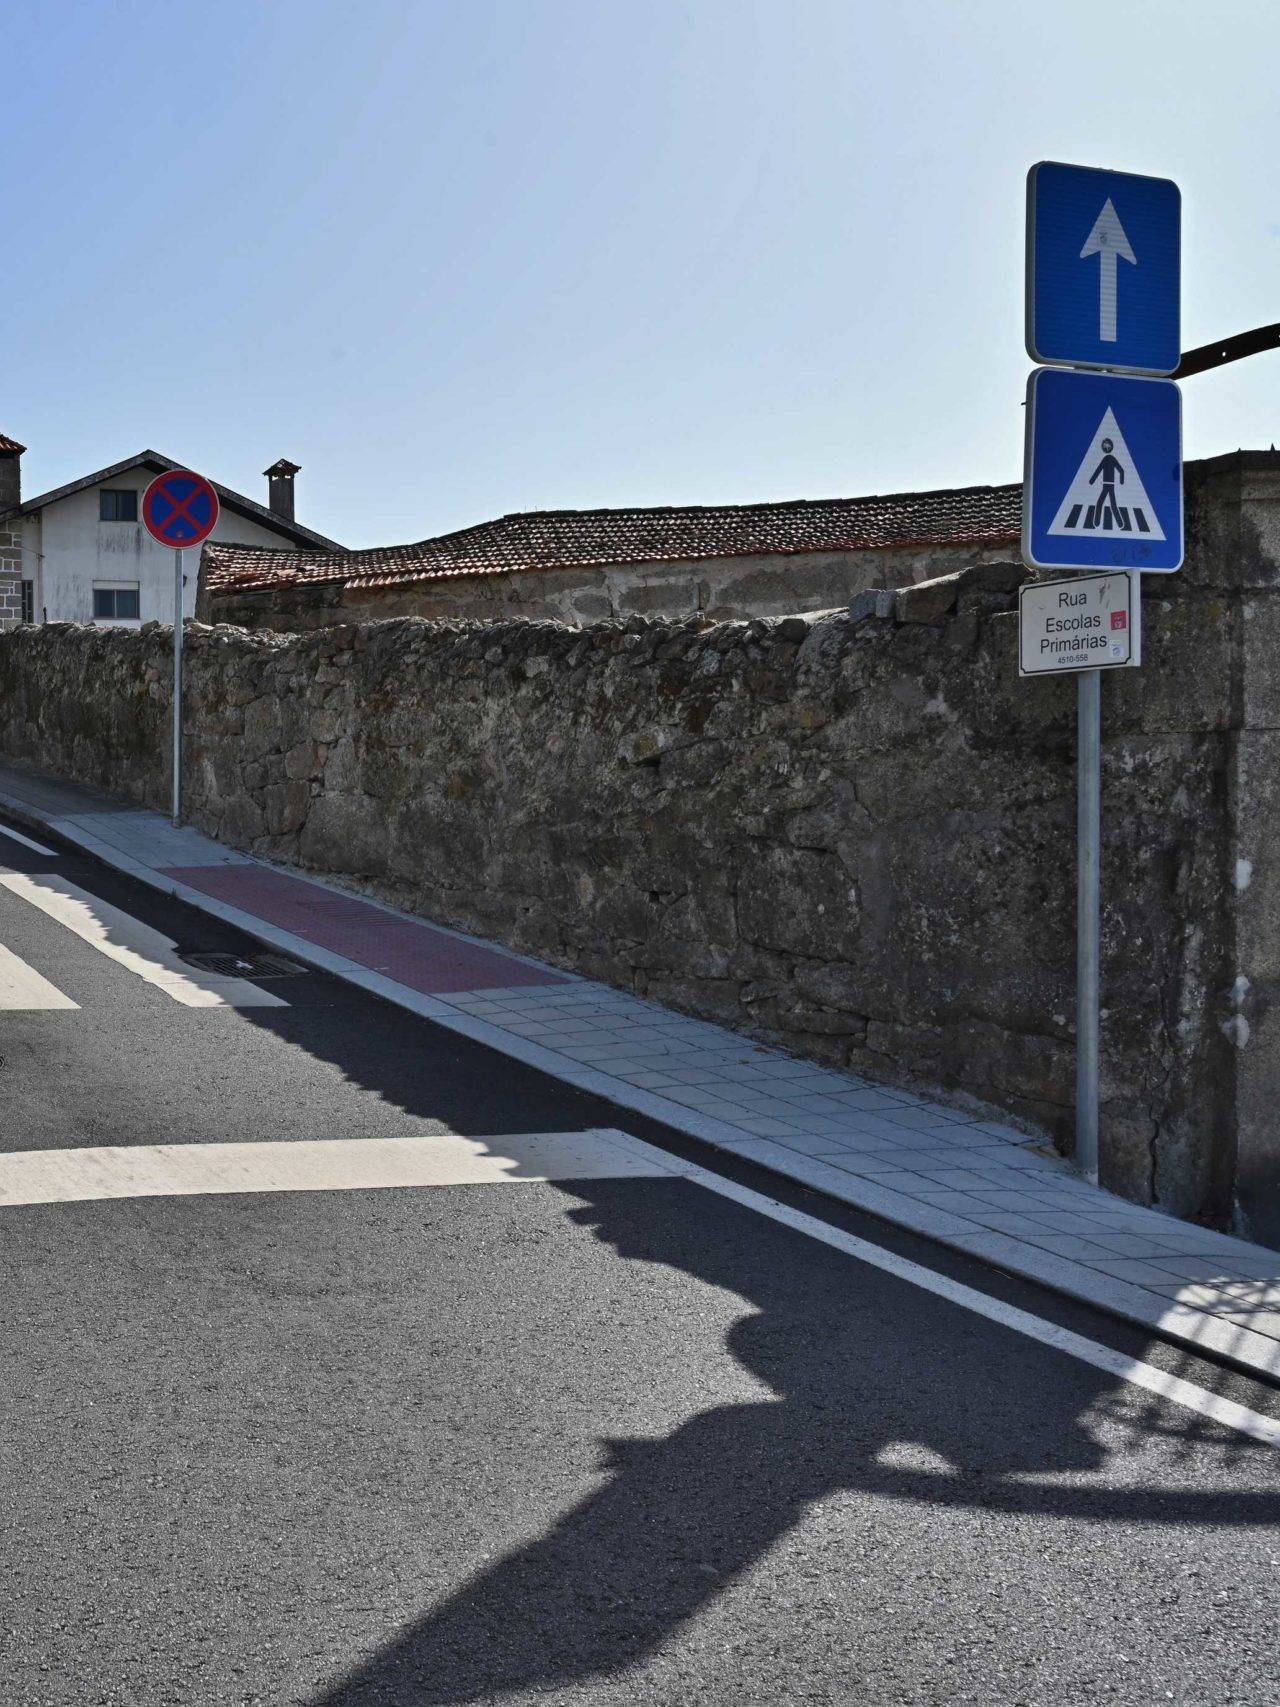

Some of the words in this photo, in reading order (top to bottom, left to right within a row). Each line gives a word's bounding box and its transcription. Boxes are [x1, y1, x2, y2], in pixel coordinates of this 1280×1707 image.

[1058, 592, 1087, 608] Rua
[1046, 614, 1101, 633] Escolas
[1040, 634, 1107, 654] Primárias
